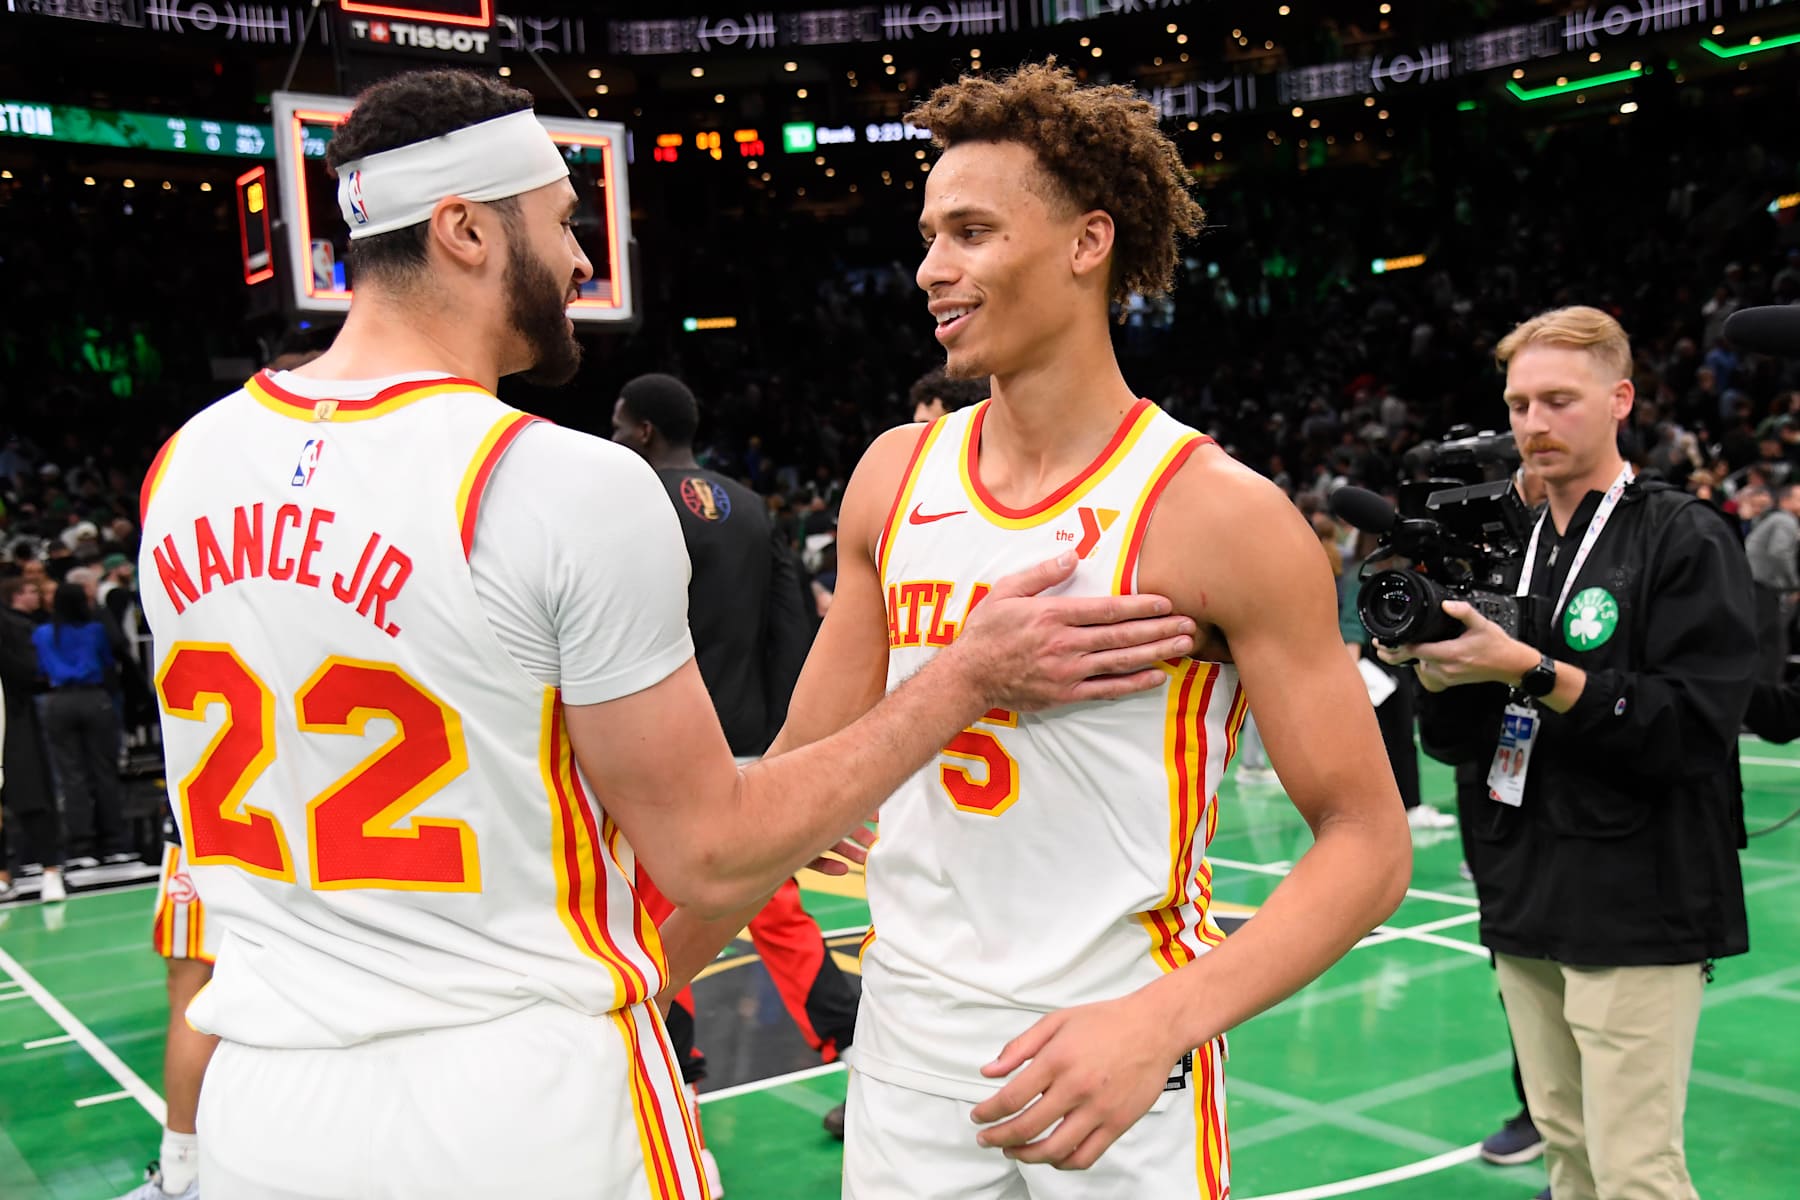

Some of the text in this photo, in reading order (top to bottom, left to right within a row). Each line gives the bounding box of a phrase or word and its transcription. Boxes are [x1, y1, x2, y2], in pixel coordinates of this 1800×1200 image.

[389, 22, 490, 54] TISSOT
[1056, 530, 1074, 541] the
[153, 502, 413, 638] NANCE JR.
[1568, 590, 1616, 621] CELTICS
[154, 640, 481, 893] 22
